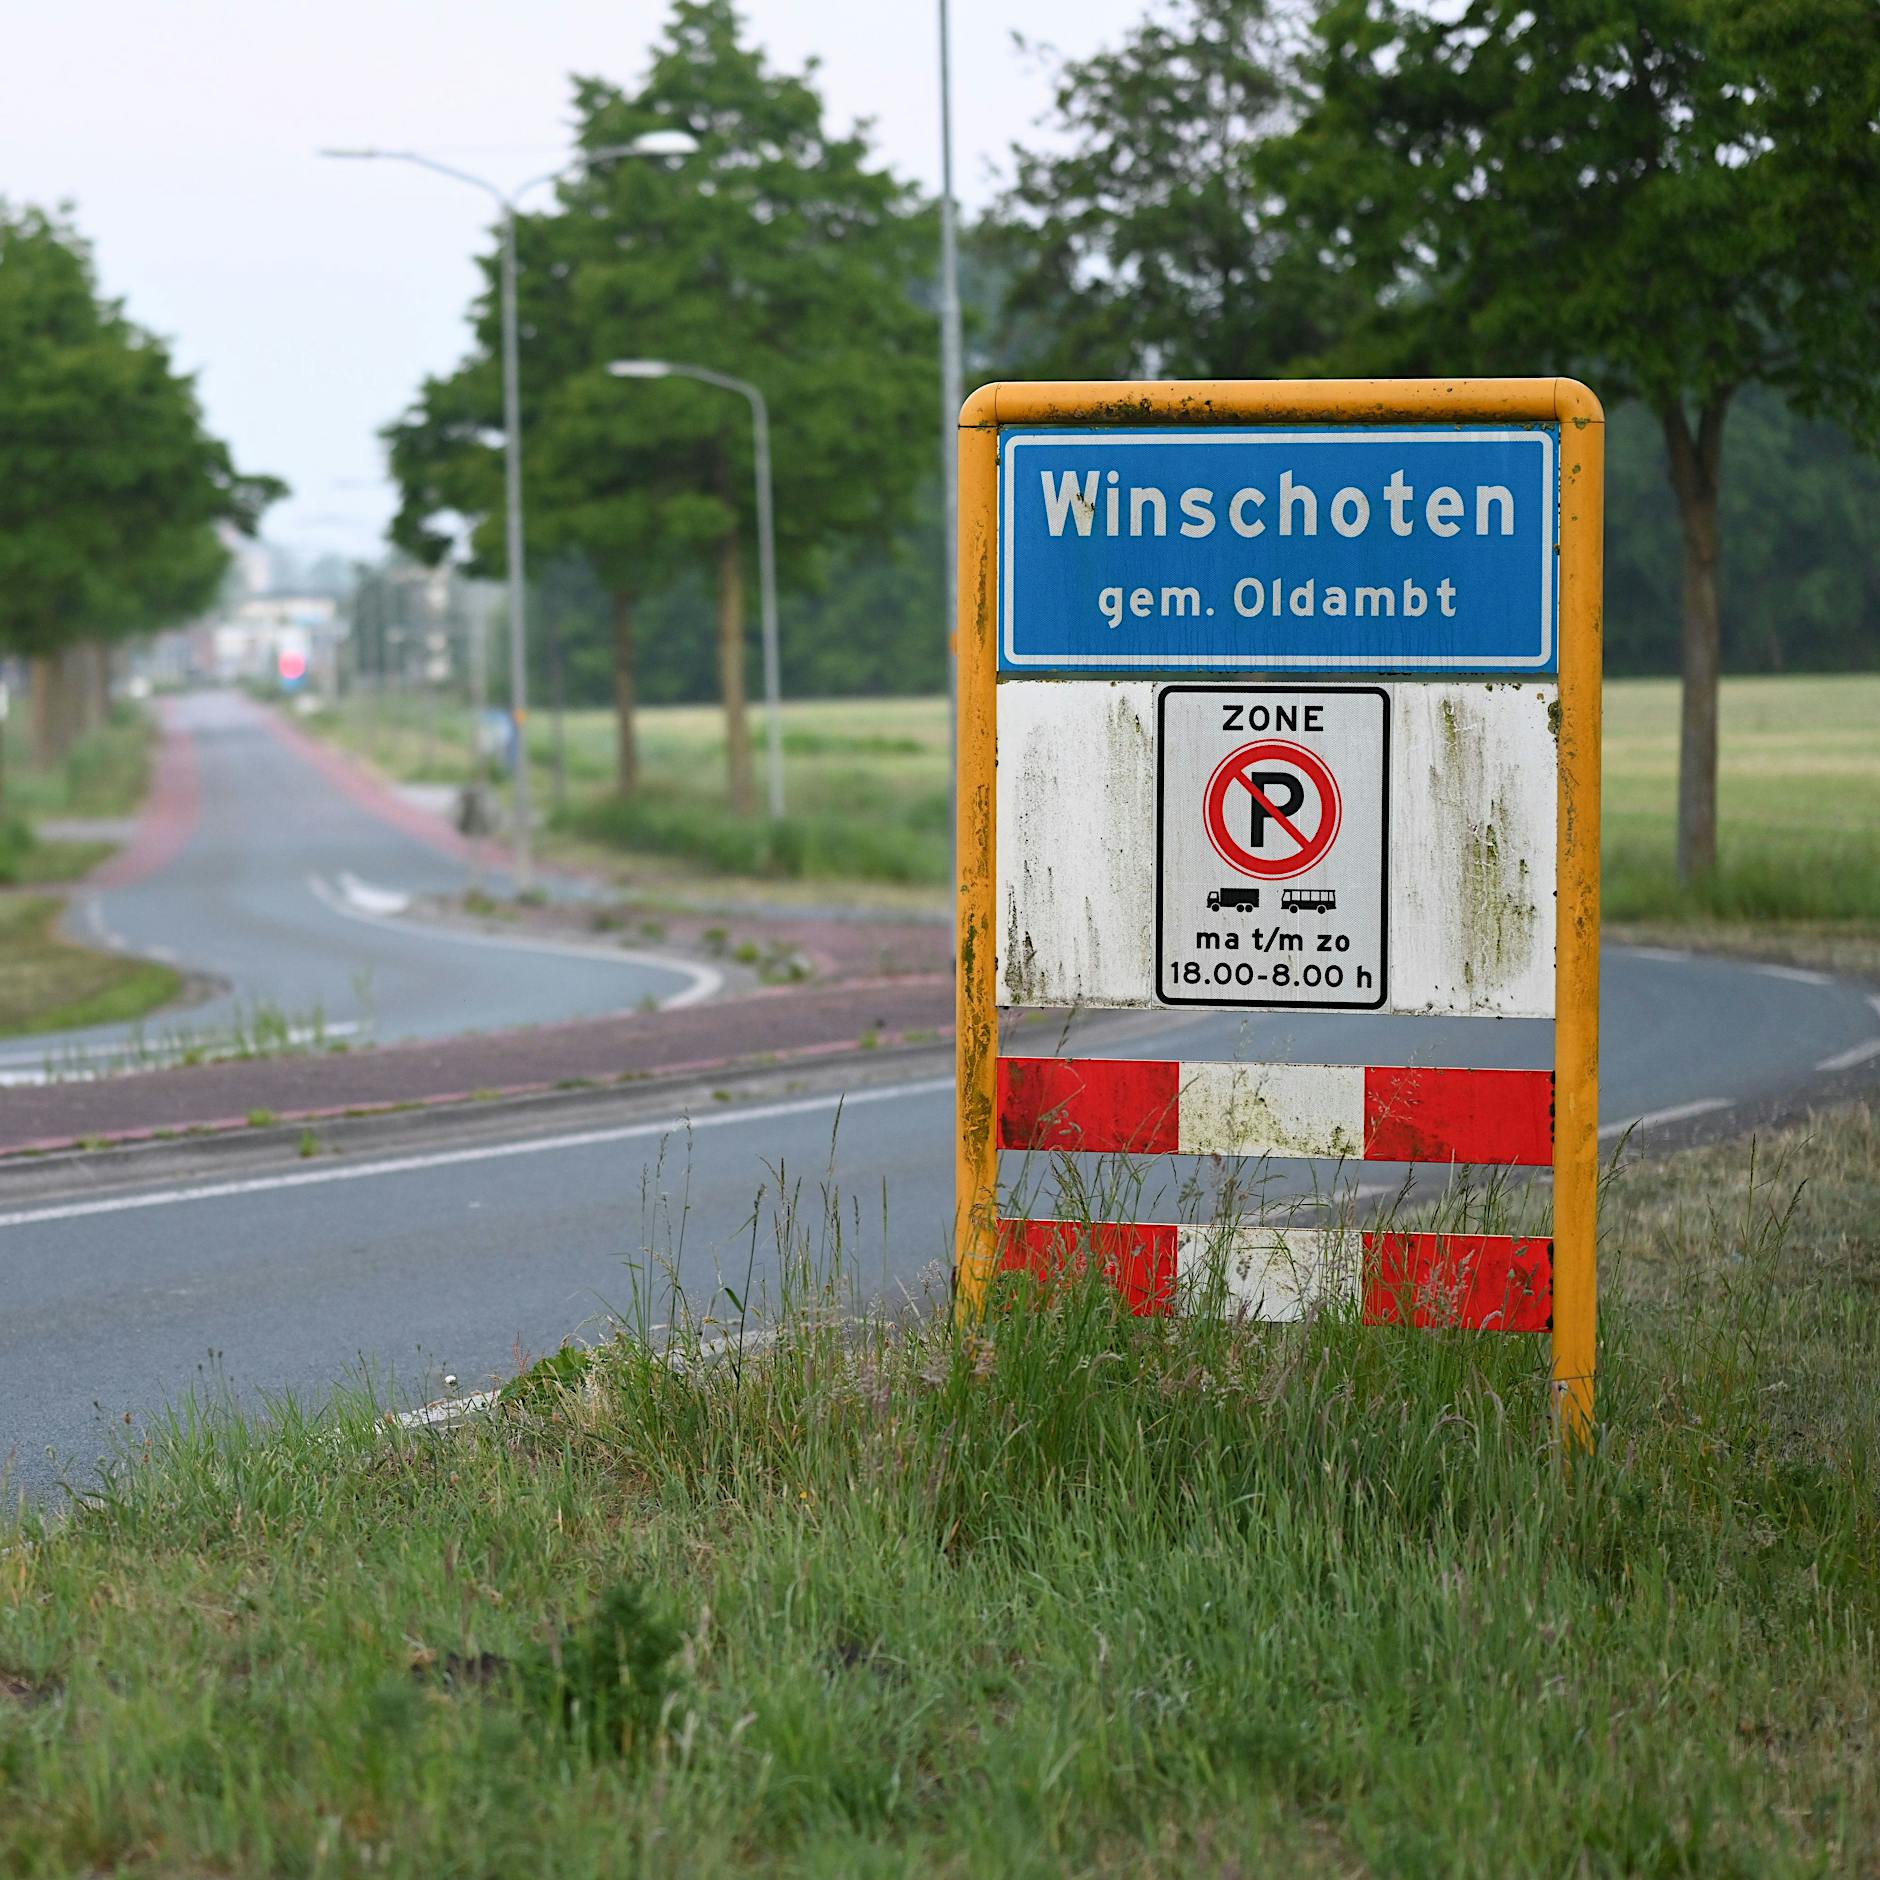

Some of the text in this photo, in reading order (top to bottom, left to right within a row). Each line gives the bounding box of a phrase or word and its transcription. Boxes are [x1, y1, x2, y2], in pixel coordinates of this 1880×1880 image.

[1040, 469, 1514, 538] Winschoten
[1098, 577, 1457, 629] gem. Oldambt
[1222, 704, 1324, 732] ZONE
[1250, 771, 1305, 848] P
[1196, 926, 1351, 953] ma t/m zo
[1170, 961, 1373, 989] 18.00-8.00 h
